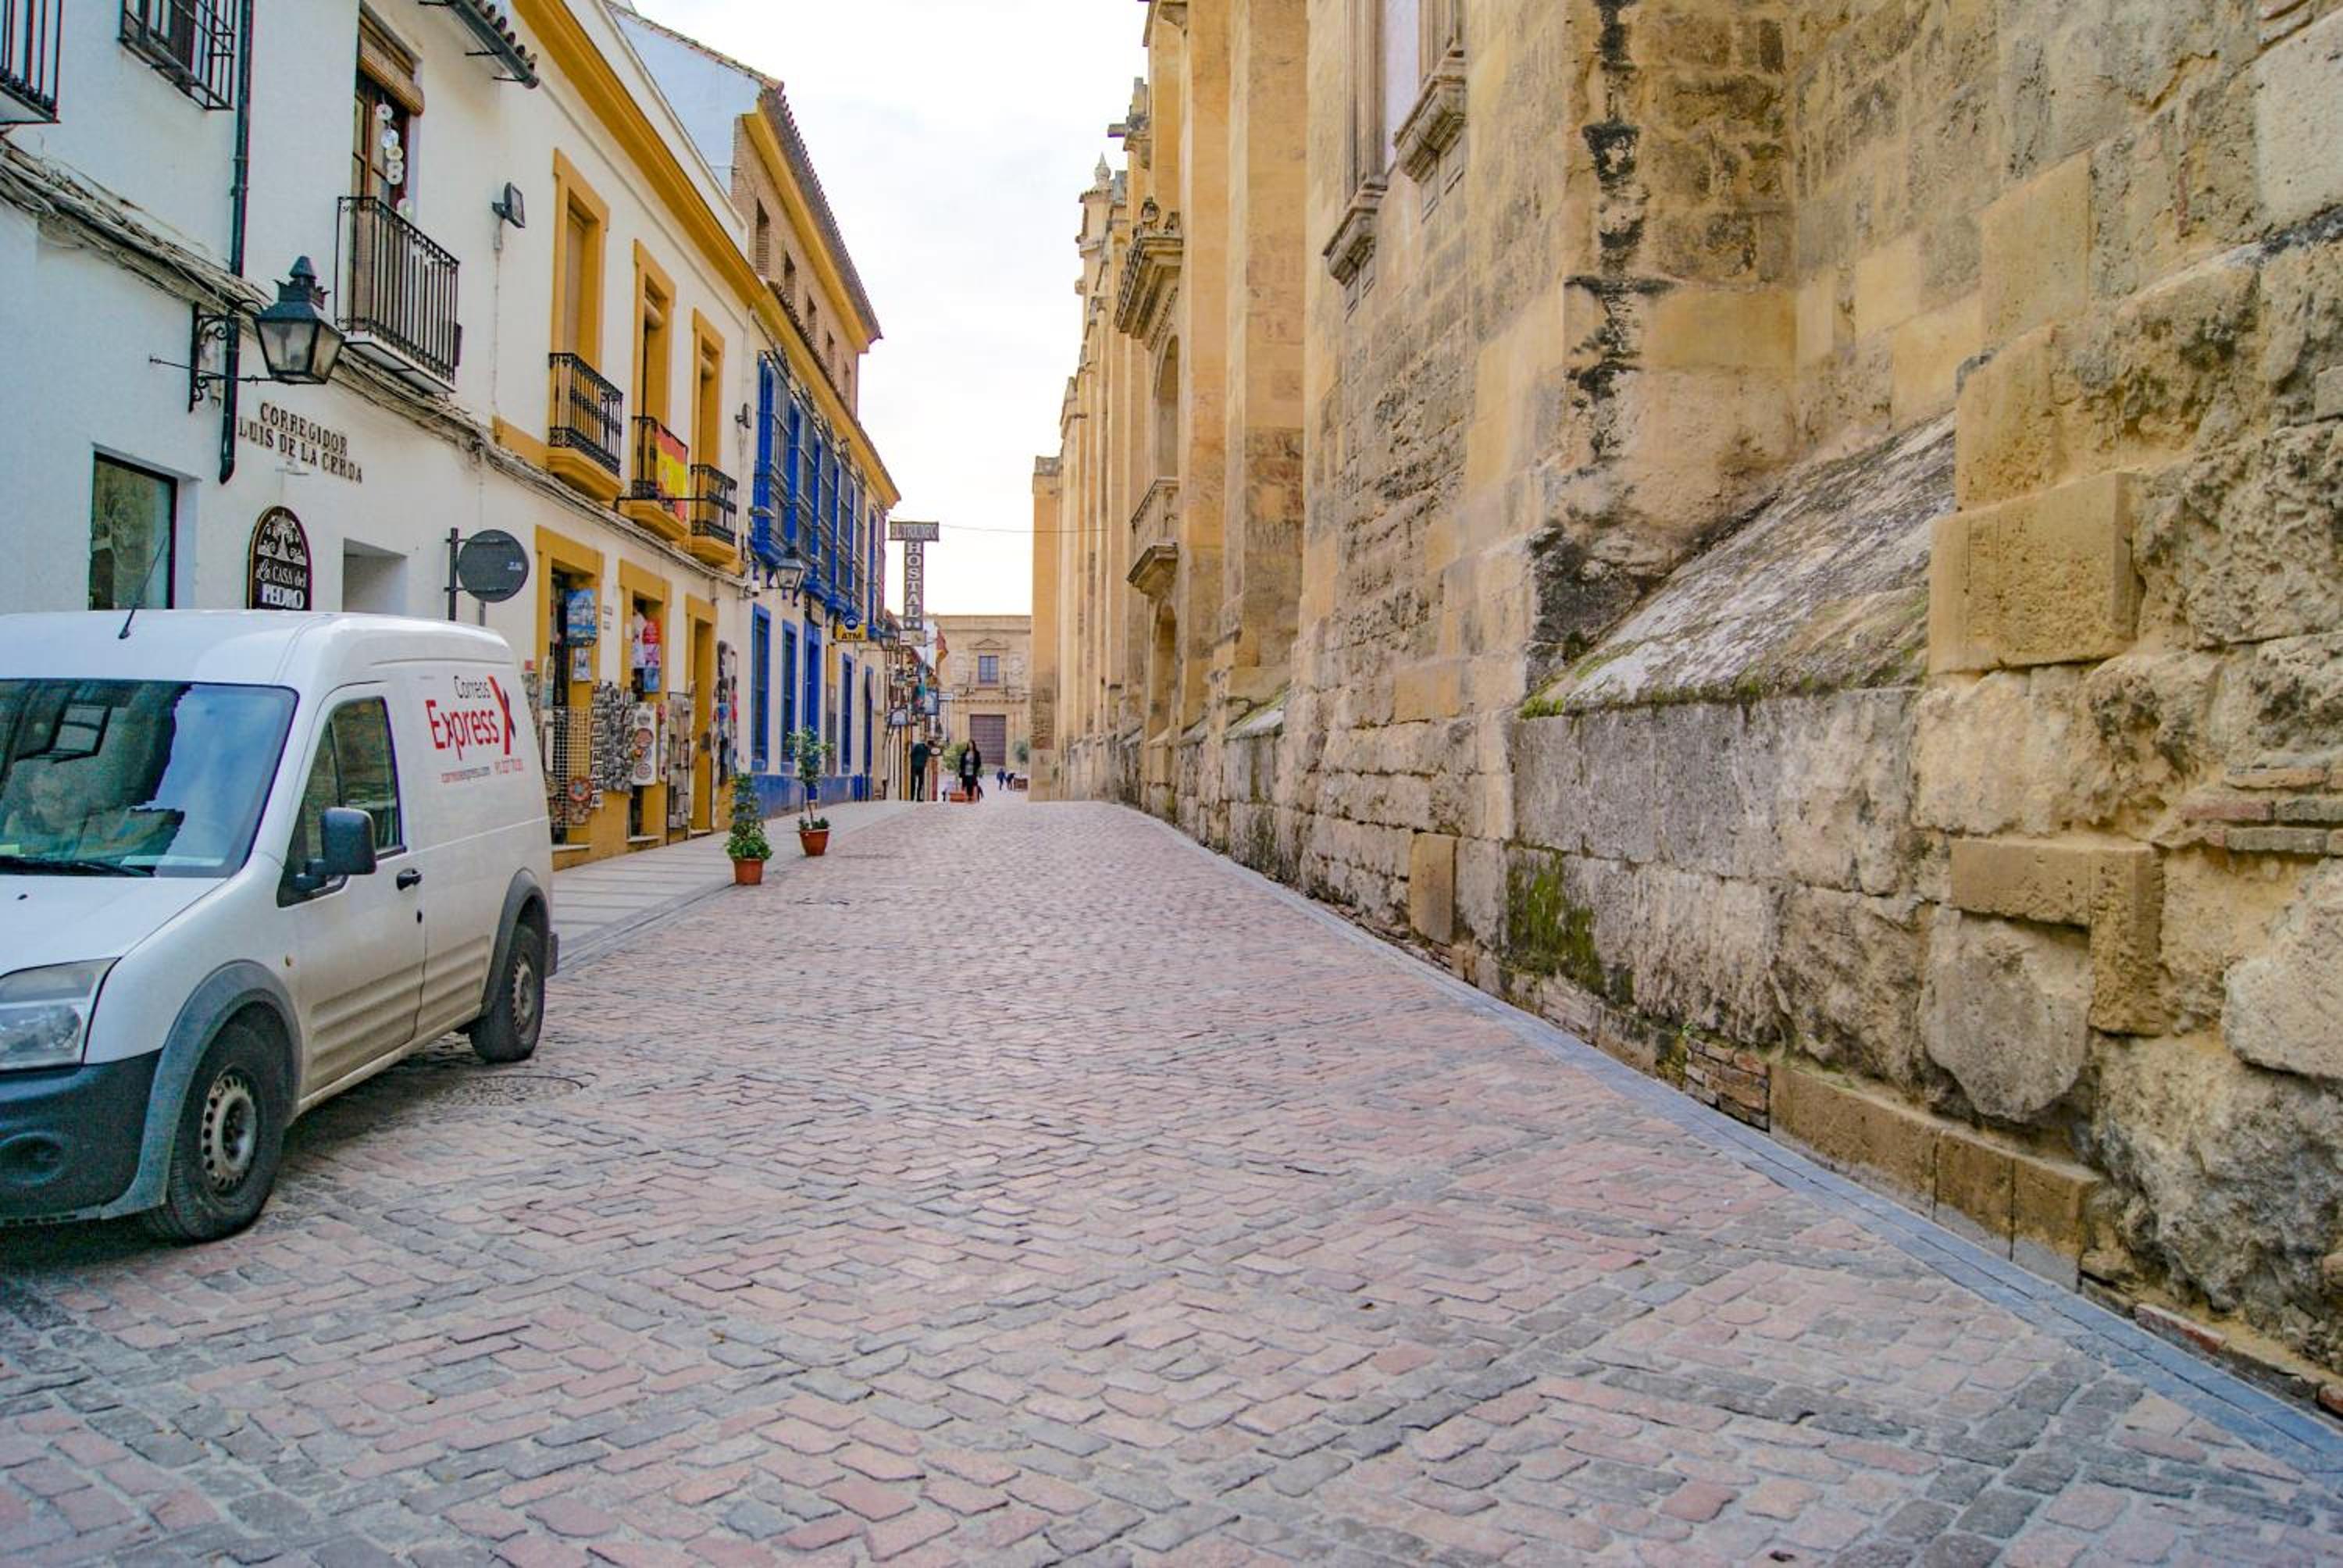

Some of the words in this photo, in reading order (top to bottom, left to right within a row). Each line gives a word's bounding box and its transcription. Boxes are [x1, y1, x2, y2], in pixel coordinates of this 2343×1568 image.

[238, 416, 274, 448] LUIS
[279, 433, 296, 458] DE
[301, 442, 318, 467] LA
[322, 451, 362, 483] CERDA
[260, 402, 348, 457] CORREGIDOR
[262, 583, 305, 609] PEDRO
[273, 565, 293, 585] CASA
[906, 541, 922, 618] HOSTAL
[454, 675, 491, 699] Correos
[425, 699, 500, 761] Express
